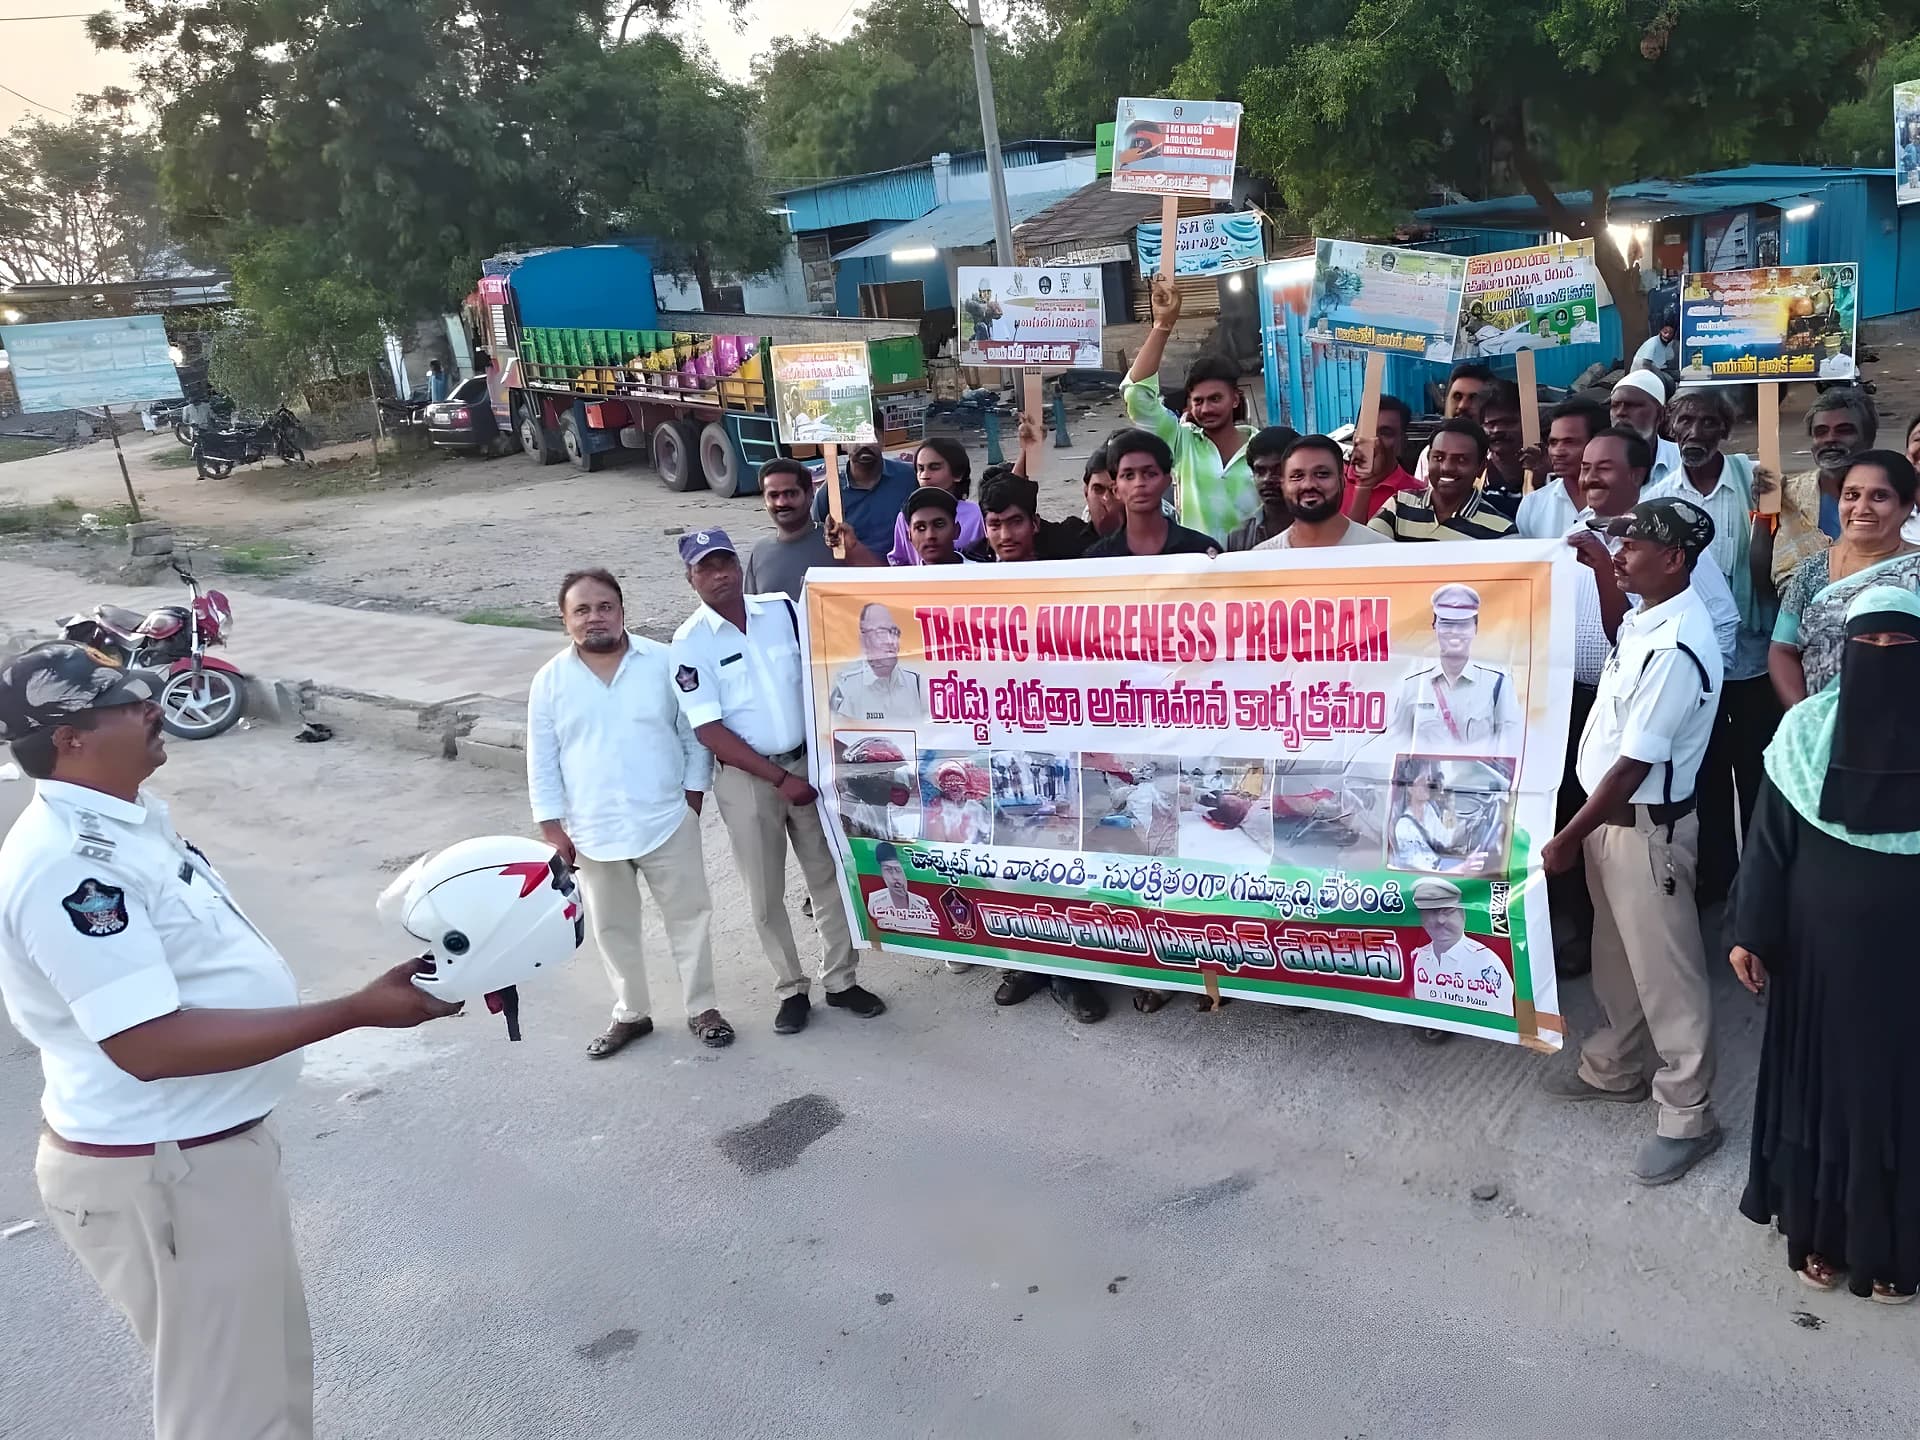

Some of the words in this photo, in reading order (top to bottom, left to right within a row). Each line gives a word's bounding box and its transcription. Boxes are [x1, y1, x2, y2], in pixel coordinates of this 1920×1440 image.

[915, 605, 1029, 662] TRAFFIC
[1036, 603, 1217, 663] AWARENESS
[1225, 598, 1389, 662] PROGRAM
[929, 670, 991, 743] రోడ్డు
[995, 678, 1082, 732] భద్రతా
[1087, 680, 1229, 728] అవగాహన
[1233, 680, 1387, 751] కార్యక్రమం
[1102, 862, 1226, 907] సురక్షితంగా
